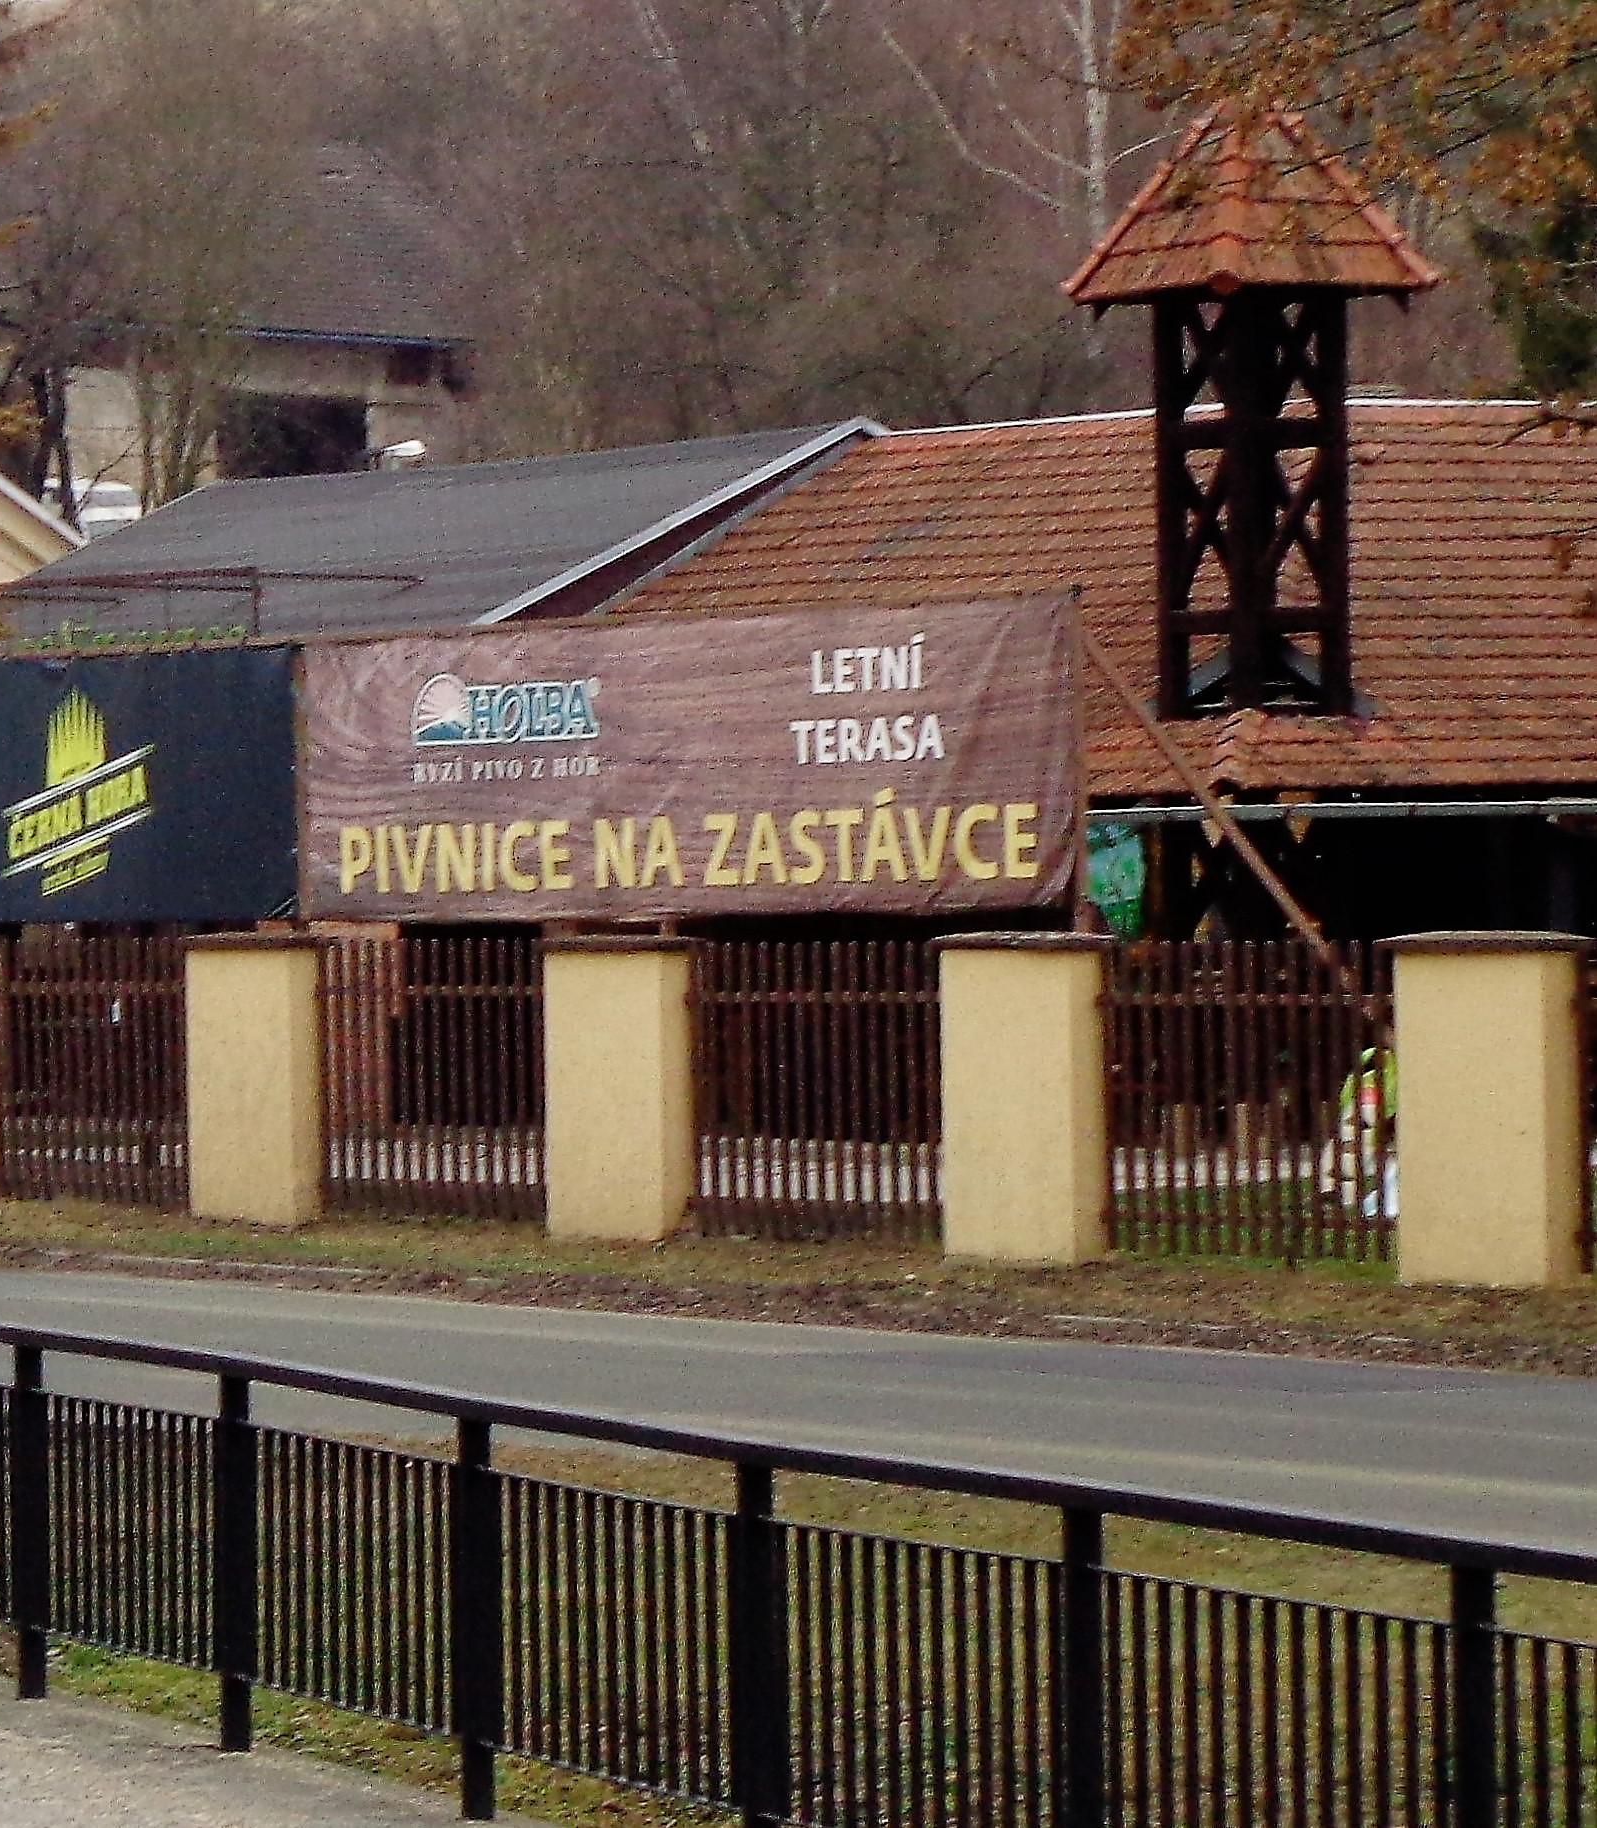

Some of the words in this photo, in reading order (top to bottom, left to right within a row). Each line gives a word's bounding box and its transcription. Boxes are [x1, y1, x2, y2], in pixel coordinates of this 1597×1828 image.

[811, 633, 925, 695] LETNÍ
[466, 682, 599, 743] HOLBA
[789, 714, 946, 766] TERASA
[471, 758, 524, 782] PIVO
[530, 757, 546, 781] Z
[338, 818, 574, 894] PIVNICE
[592, 814, 684, 888] NA
[702, 787, 1039, 886] ZASTÁVCE
